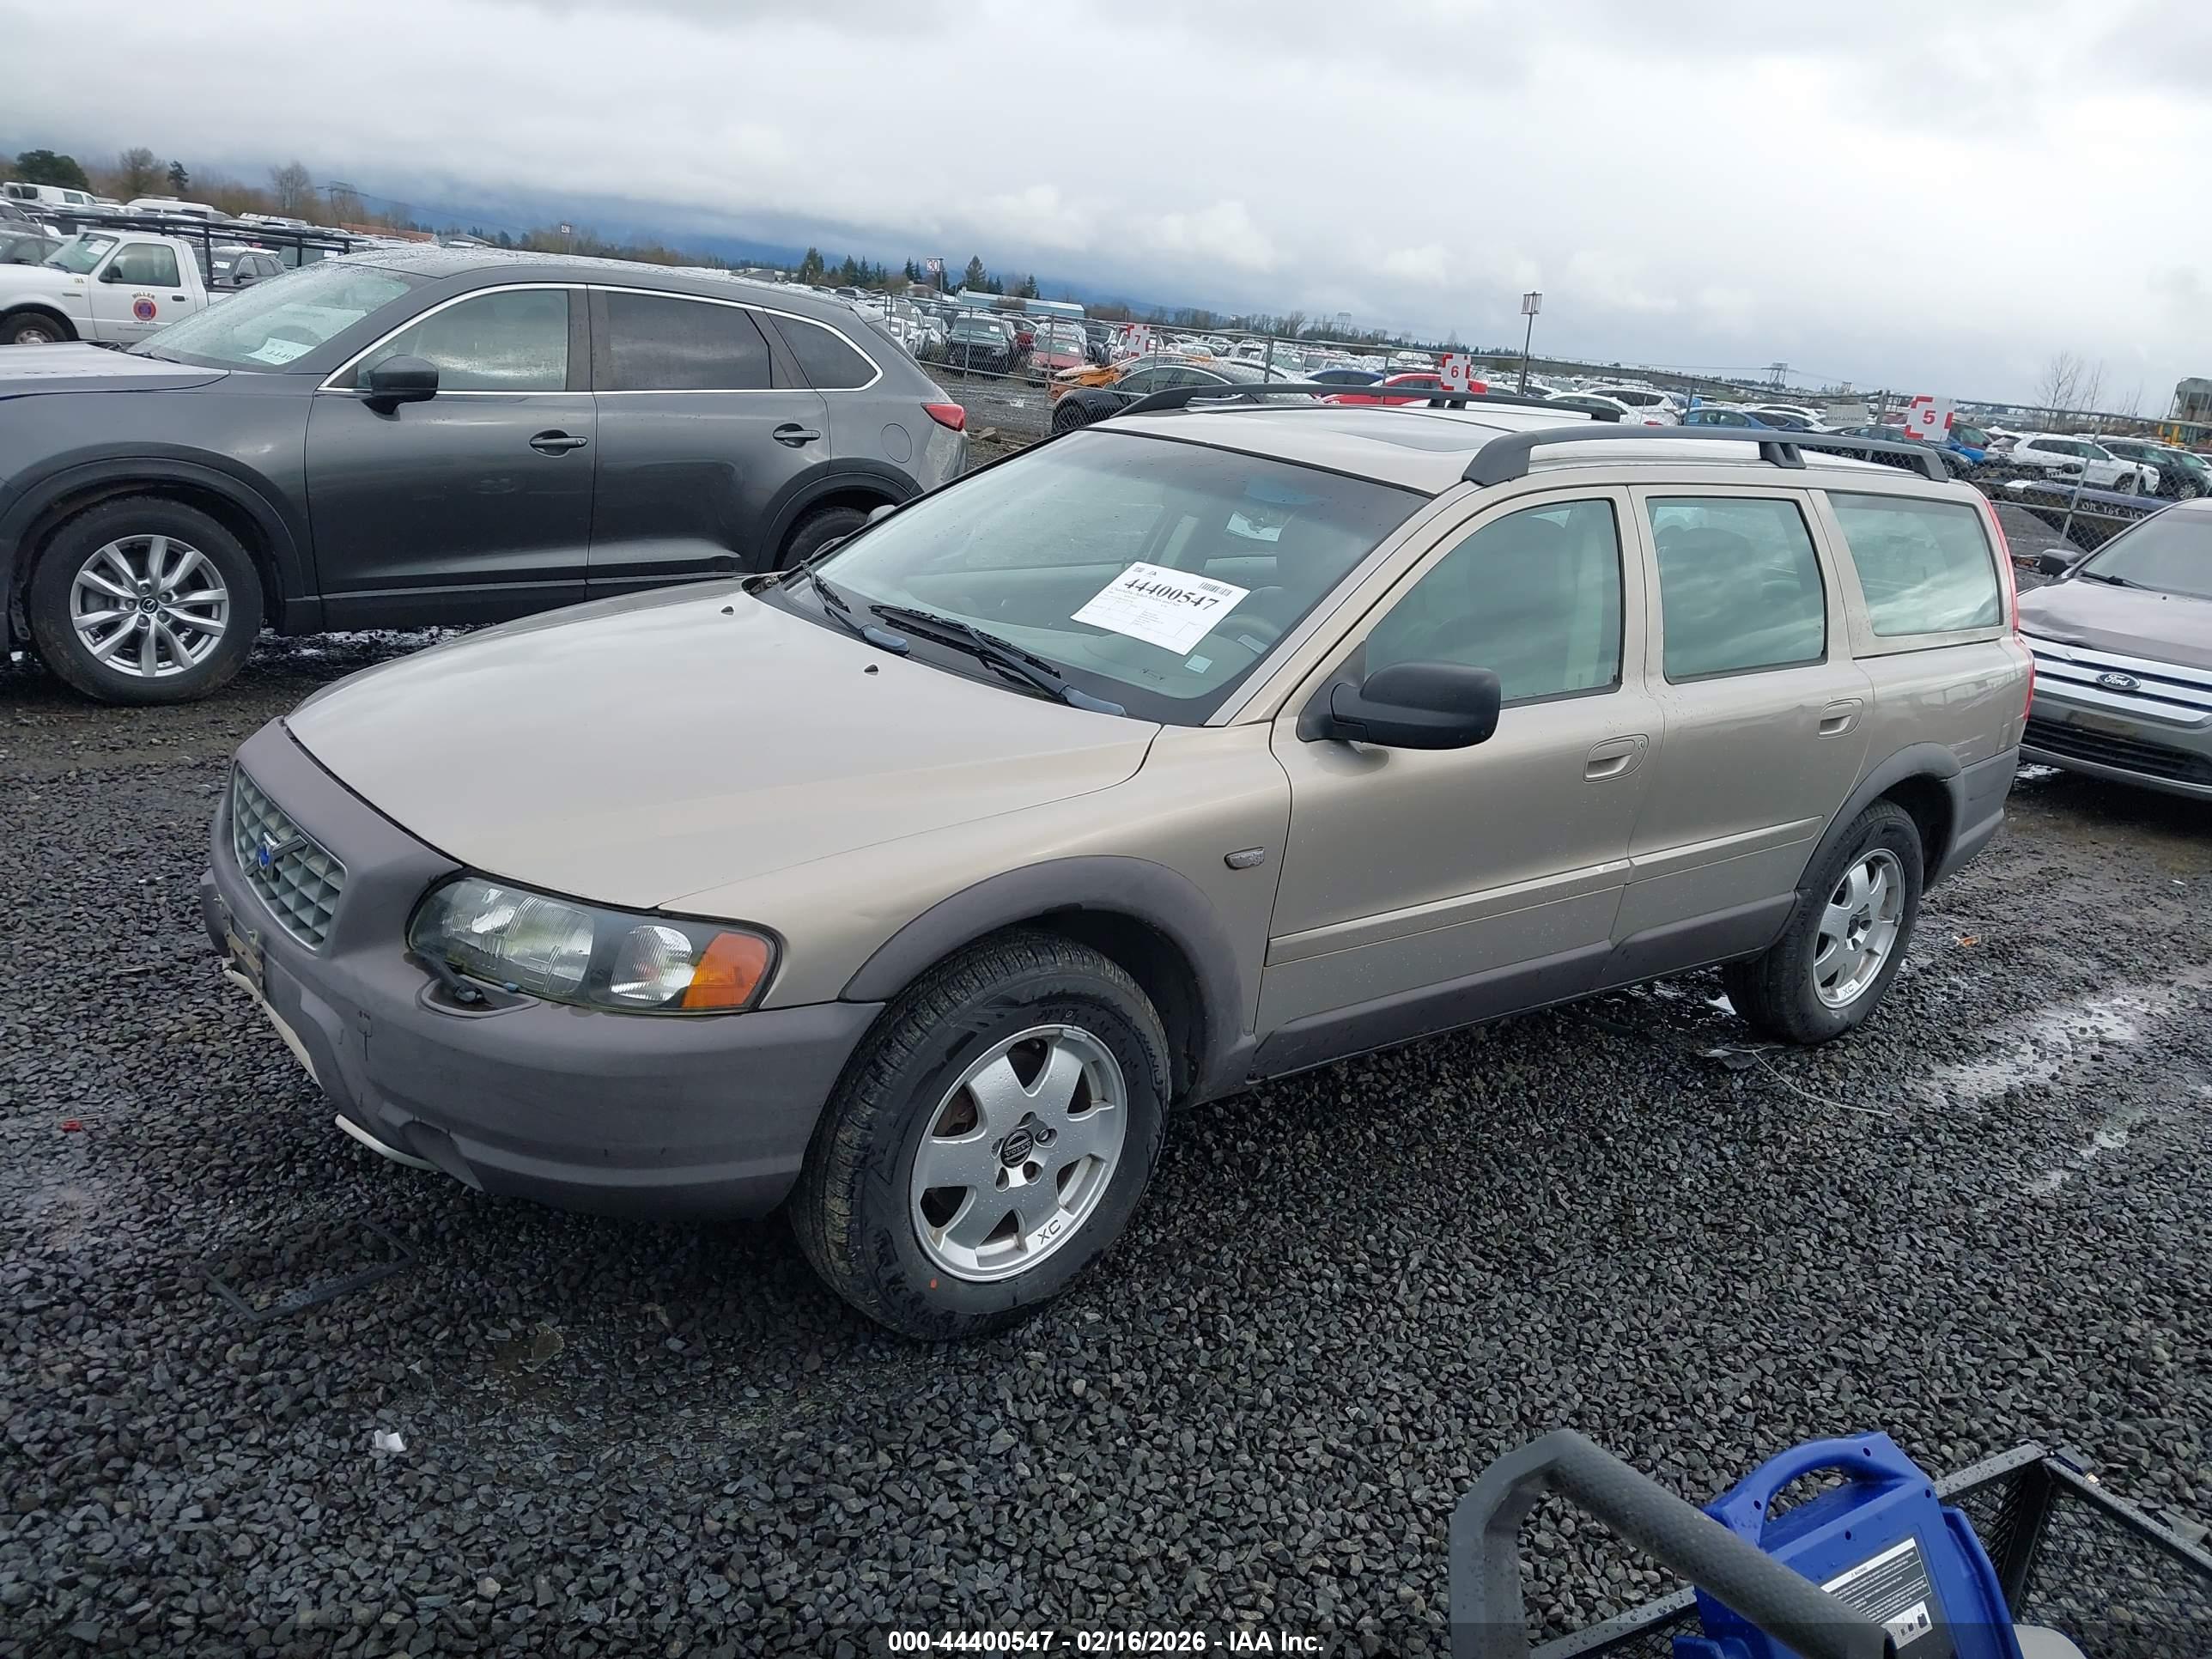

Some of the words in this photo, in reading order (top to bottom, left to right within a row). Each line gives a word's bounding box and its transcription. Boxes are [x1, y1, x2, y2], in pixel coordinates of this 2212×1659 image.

[927, 259, 939, 271] 30
[1134, 334, 1141, 345] 7
[1451, 365, 1460, 378] 6
[1923, 410, 1936, 424] 5
[1123, 578, 1220, 611] 44400547
[2104, 674, 2130, 686] Ford
[1842, 984, 1854, 997] XC
[1004, 1140, 1031, 1157] VOLVO
[1036, 1219, 1062, 1245] XC
